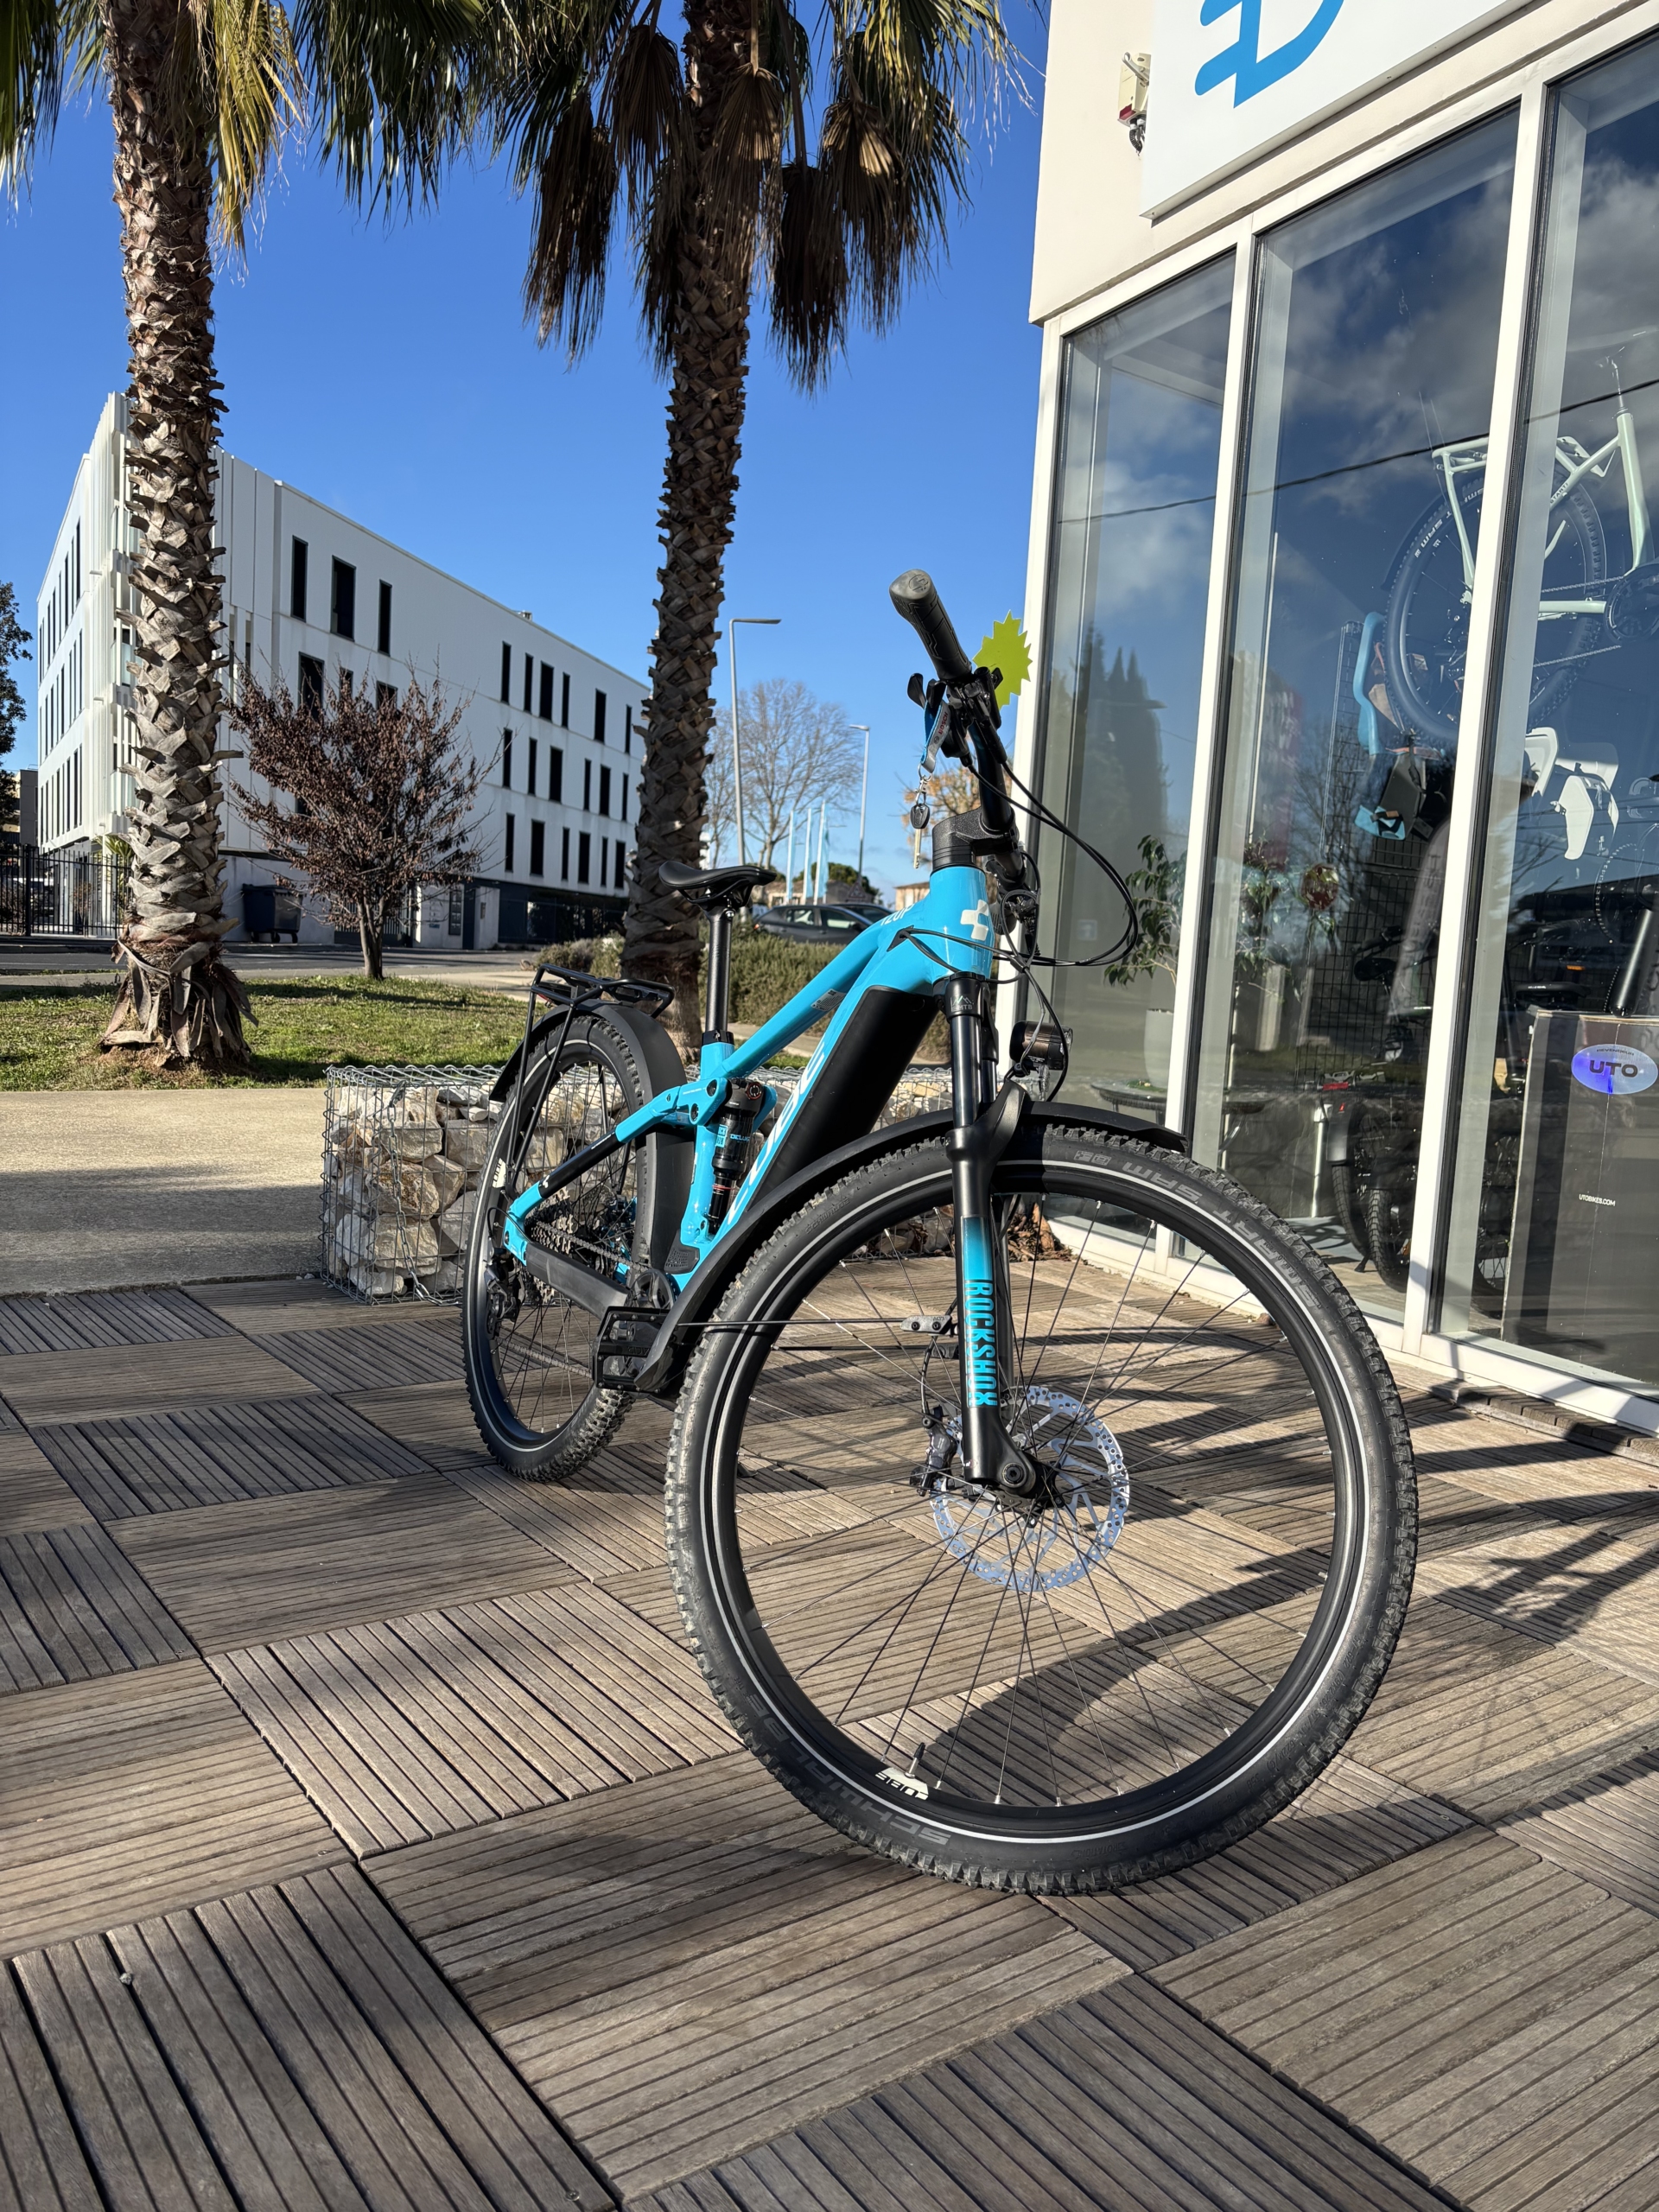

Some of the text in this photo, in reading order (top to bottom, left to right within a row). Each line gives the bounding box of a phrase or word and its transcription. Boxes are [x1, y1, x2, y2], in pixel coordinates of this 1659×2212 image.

[938, 711, 948, 735] BOSCH
[1589, 1059, 1638, 1078] UTO
[728, 1040, 826, 1225] CUBE
[1122, 1161, 1204, 1201] SAM
[1579, 1193, 1616, 1207] UTOBIKES.COM
[1213, 1209, 1317, 1308] SMART
[964, 1282, 998, 1408] ROCKSHOX
[745, 1694, 952, 1846] SCHWALBE
